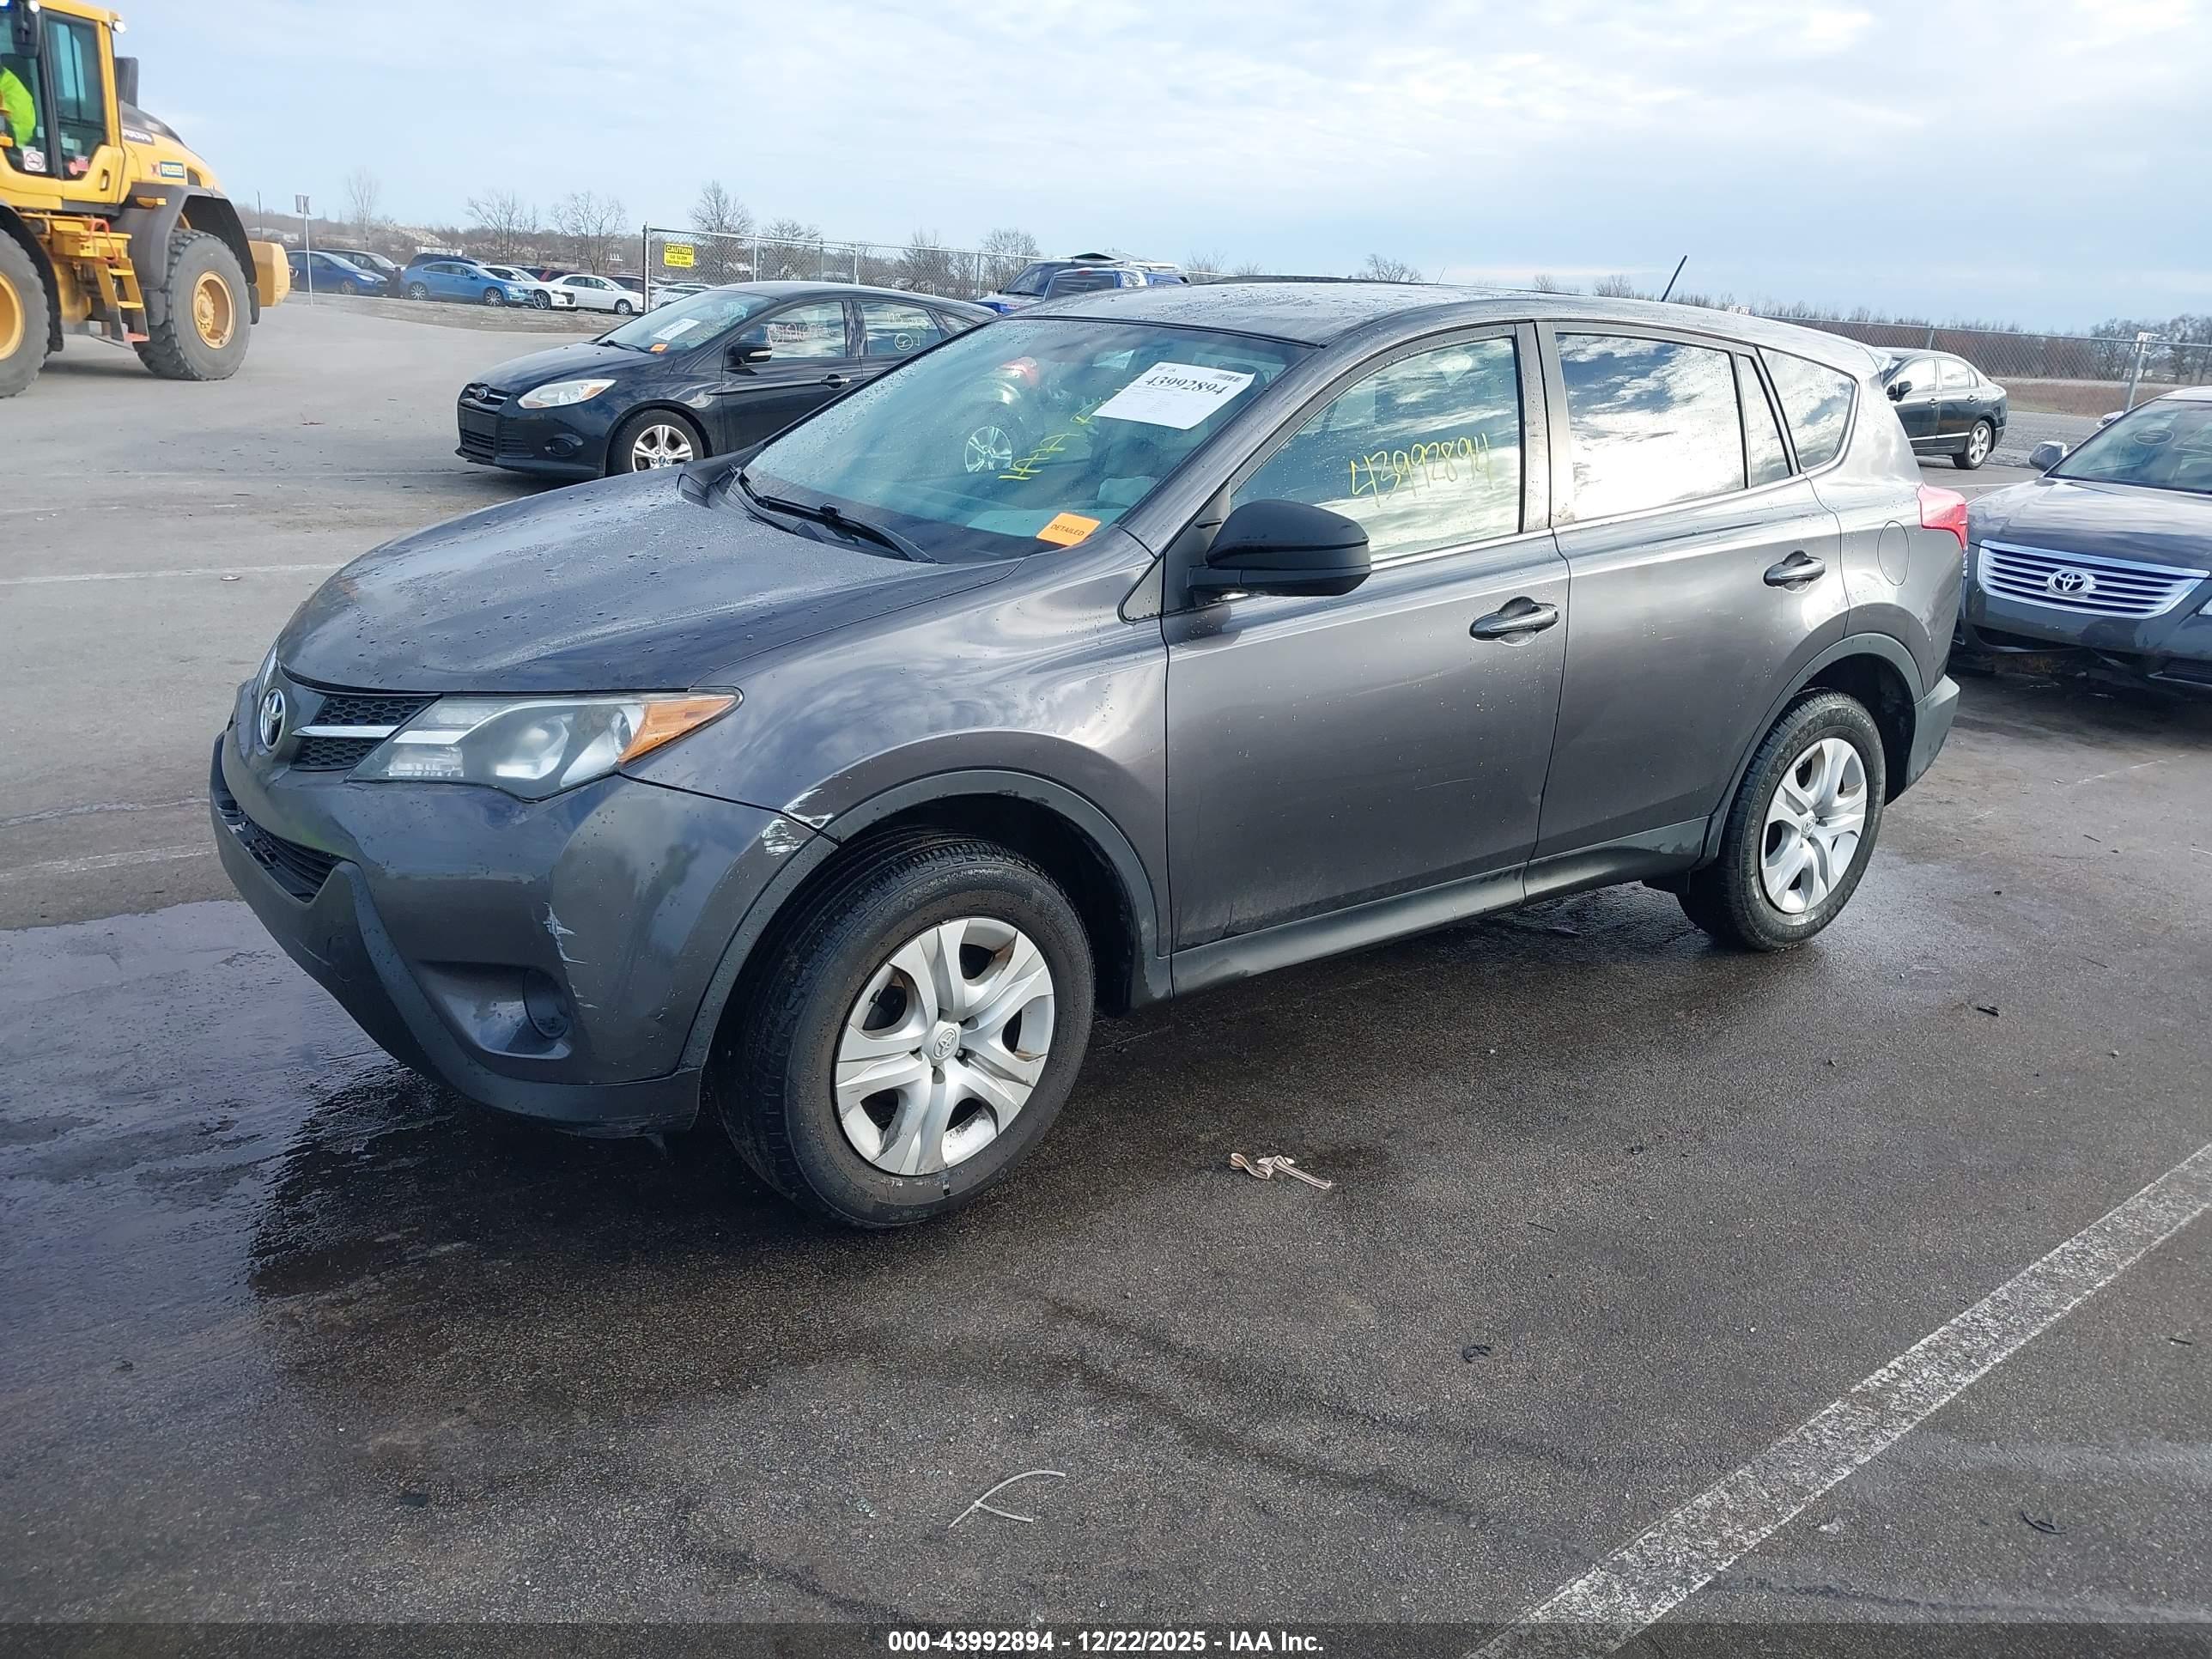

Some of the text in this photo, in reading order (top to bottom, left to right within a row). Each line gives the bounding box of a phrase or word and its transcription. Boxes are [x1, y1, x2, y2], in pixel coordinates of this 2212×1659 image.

[666, 246, 692, 255] CAUTION
[1145, 375, 1230, 395] 43992894
[1350, 432, 1493, 508] 43992894
[1050, 524, 1085, 537] DETAILED
